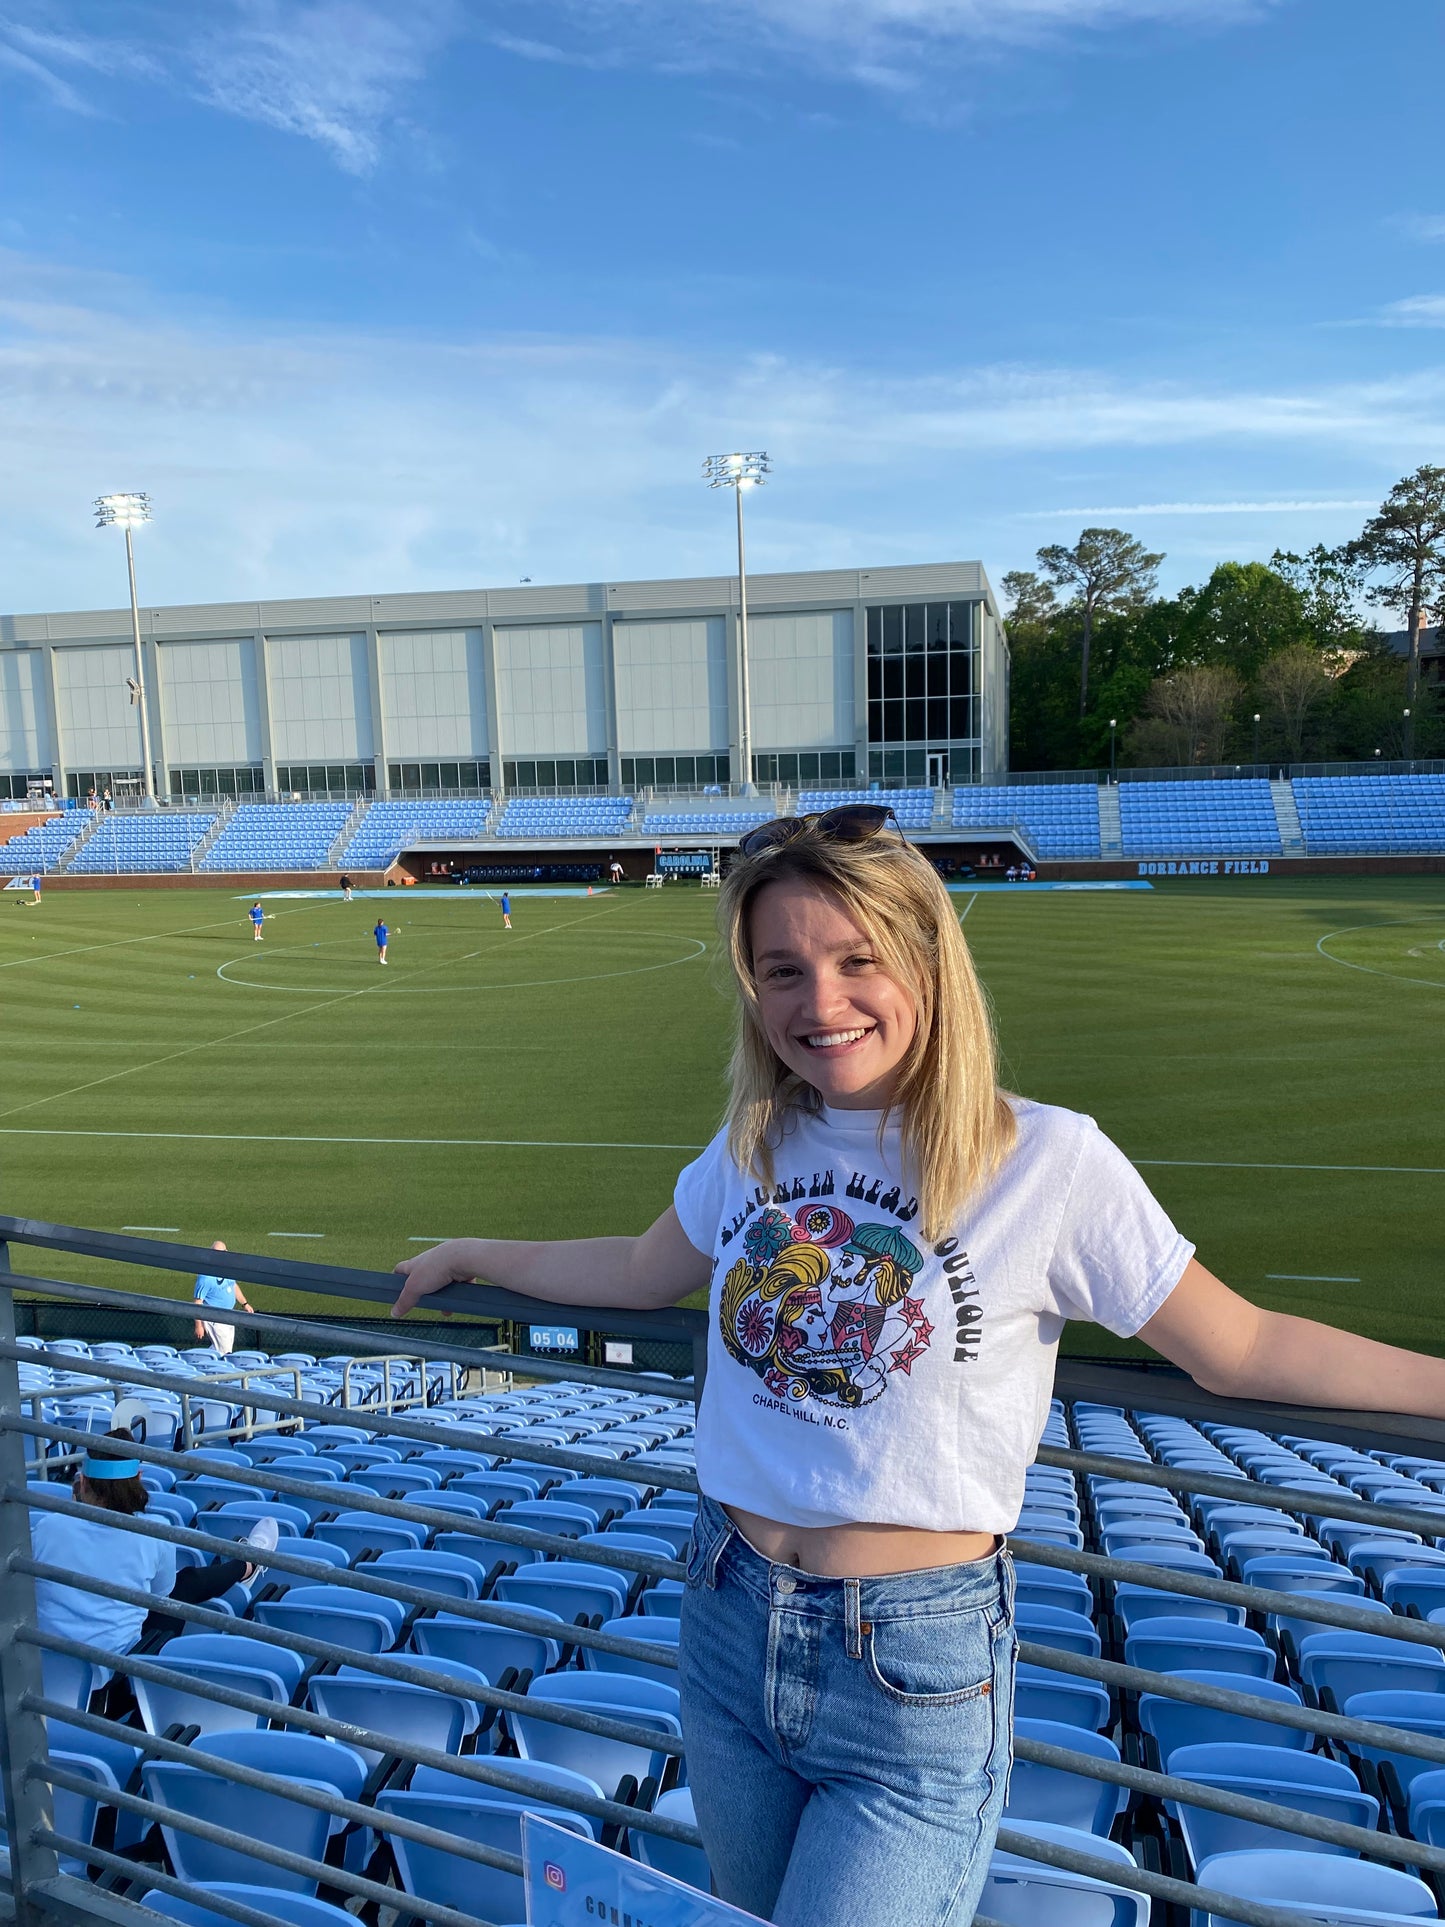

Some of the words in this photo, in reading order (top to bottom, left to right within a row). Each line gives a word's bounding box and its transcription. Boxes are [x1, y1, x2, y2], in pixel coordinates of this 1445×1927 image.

[660, 856, 710, 866] CAROLINA
[1138, 862, 1219, 875] DORRANCE
[1224, 861, 1269, 874] FIELD
[920, 1227, 984, 1363] OUTIQUE
[533, 1332, 551, 1345] 05
[557, 1333, 576, 1346] 04
[752, 1394, 791, 1415] CHAPEL
[793, 1408, 820, 1426] HILL,
[824, 1415, 850, 1430] N.C.
